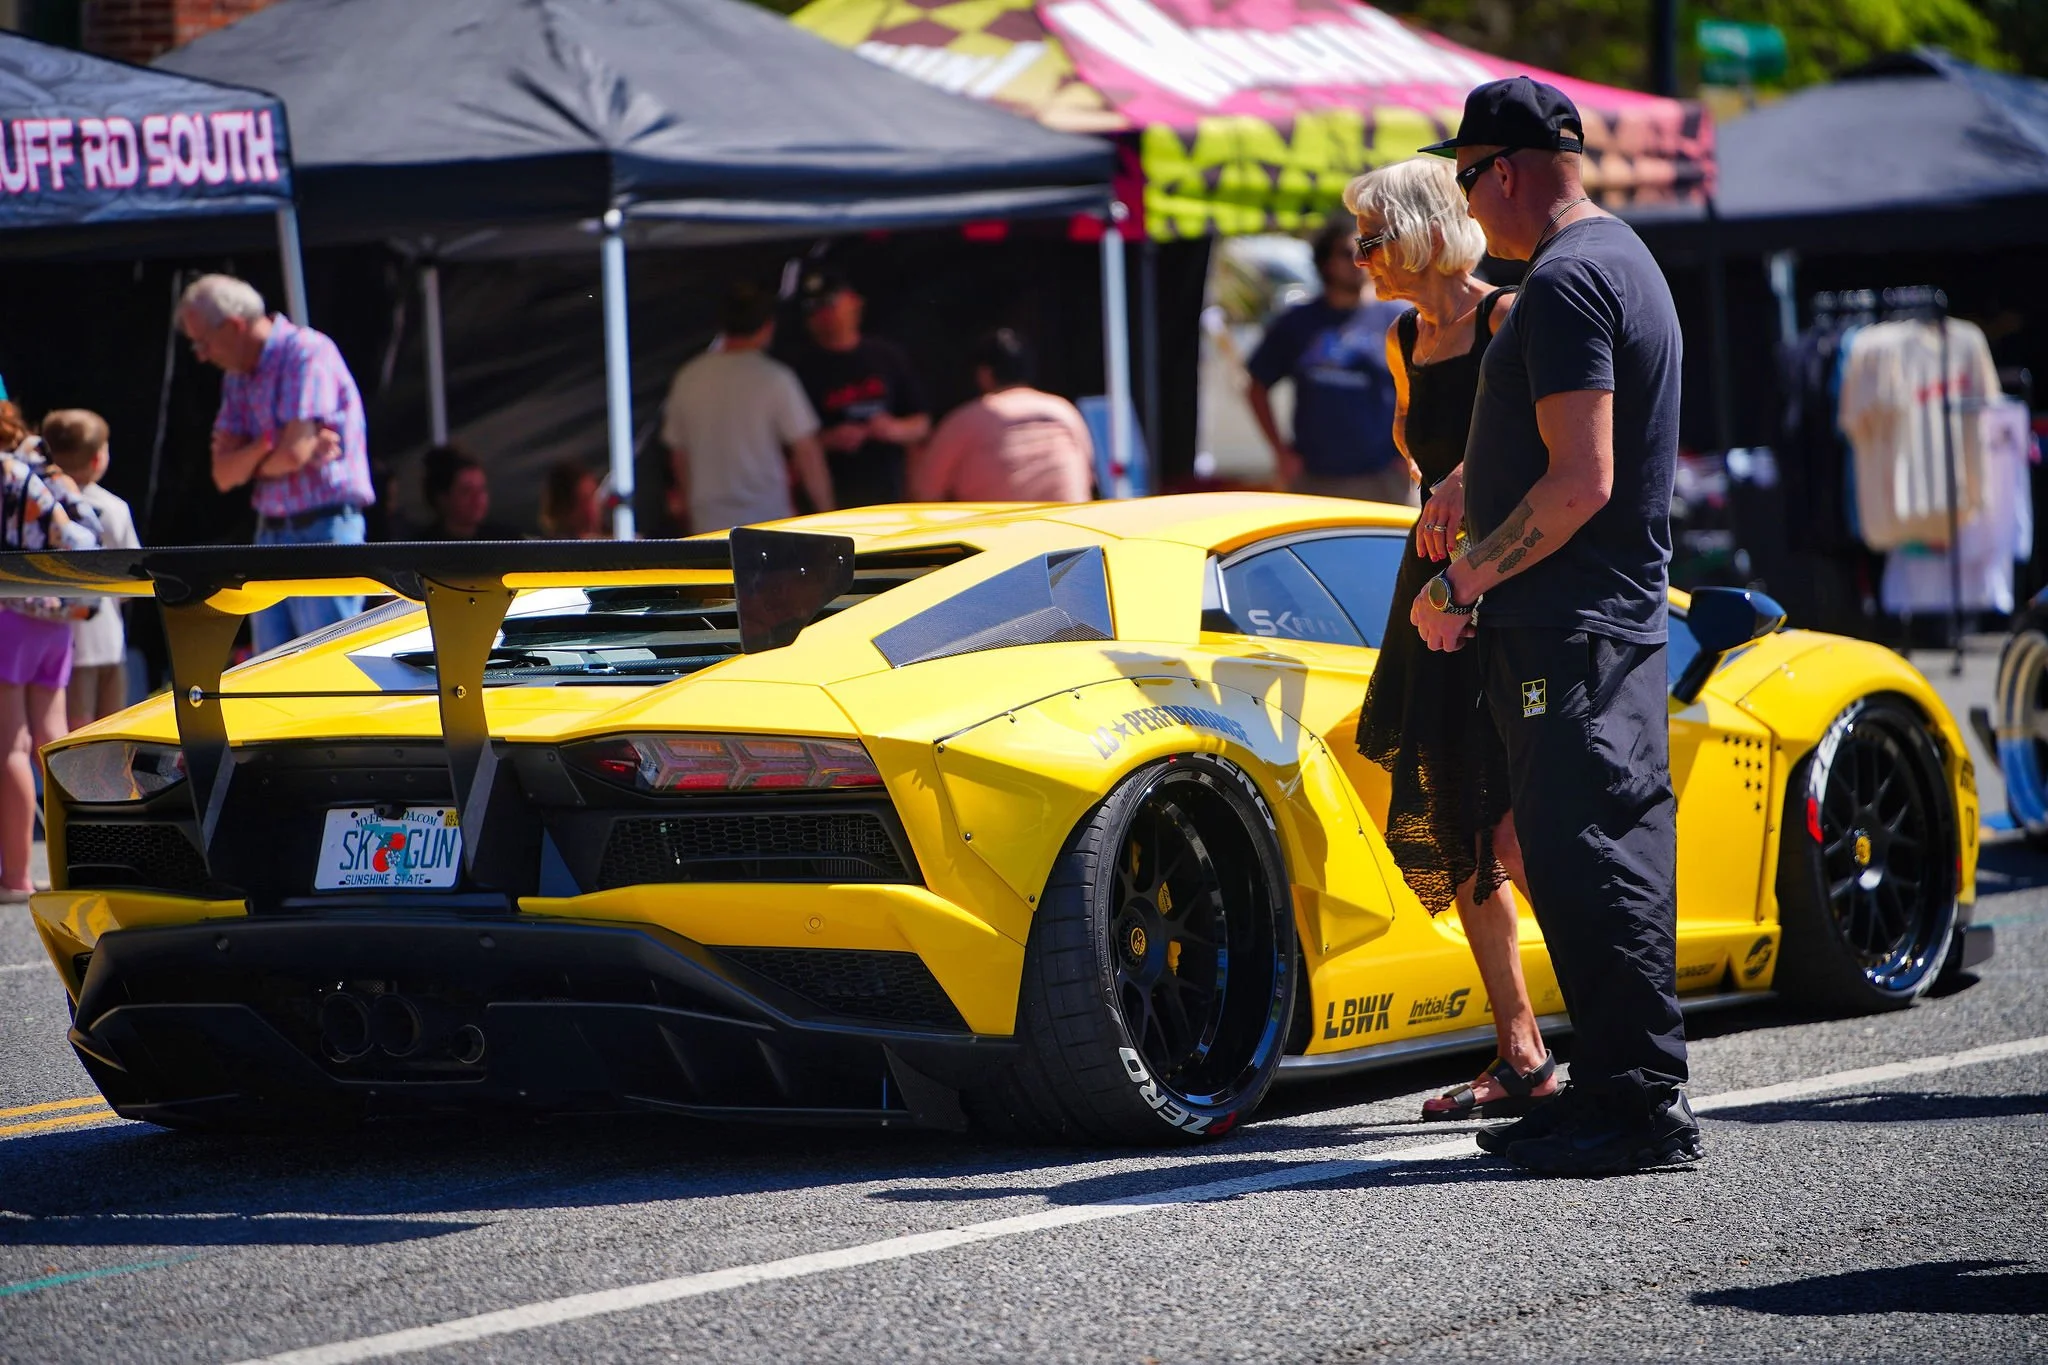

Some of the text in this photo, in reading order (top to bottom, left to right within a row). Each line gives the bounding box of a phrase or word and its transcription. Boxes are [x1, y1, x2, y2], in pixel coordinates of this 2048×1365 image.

[0, 109, 279, 192] UFF RD SOUTH
[1121, 704, 1254, 749] PERFORMANCE
[355, 810, 438, 828] MYFLDA.COM
[403, 828, 457, 868] GUN
[345, 873, 425, 885] SUNSHINE STATE
[1323, 993, 1394, 1040] LBWK
[1119, 1047, 1213, 1135] ZERO
